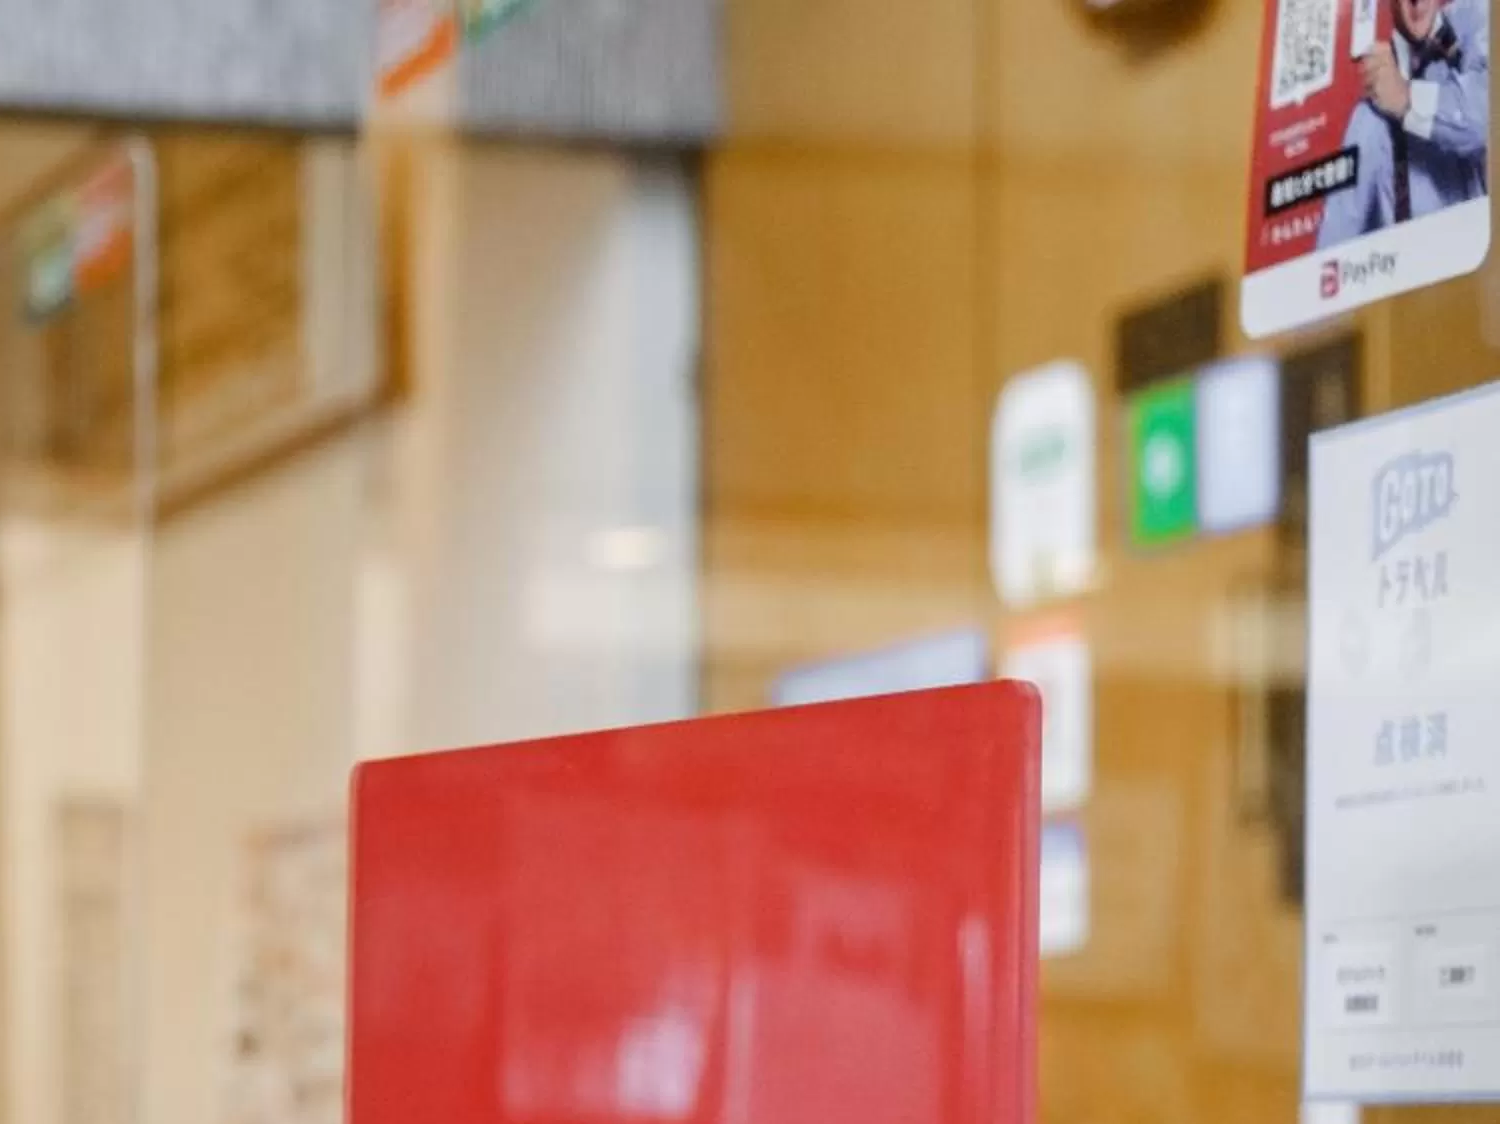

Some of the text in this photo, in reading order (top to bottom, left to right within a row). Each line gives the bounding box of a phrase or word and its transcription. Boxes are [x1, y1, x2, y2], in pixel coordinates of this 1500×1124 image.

[1342, 250, 1398, 286] PayPay
[1378, 551, 1449, 608] トラベル
